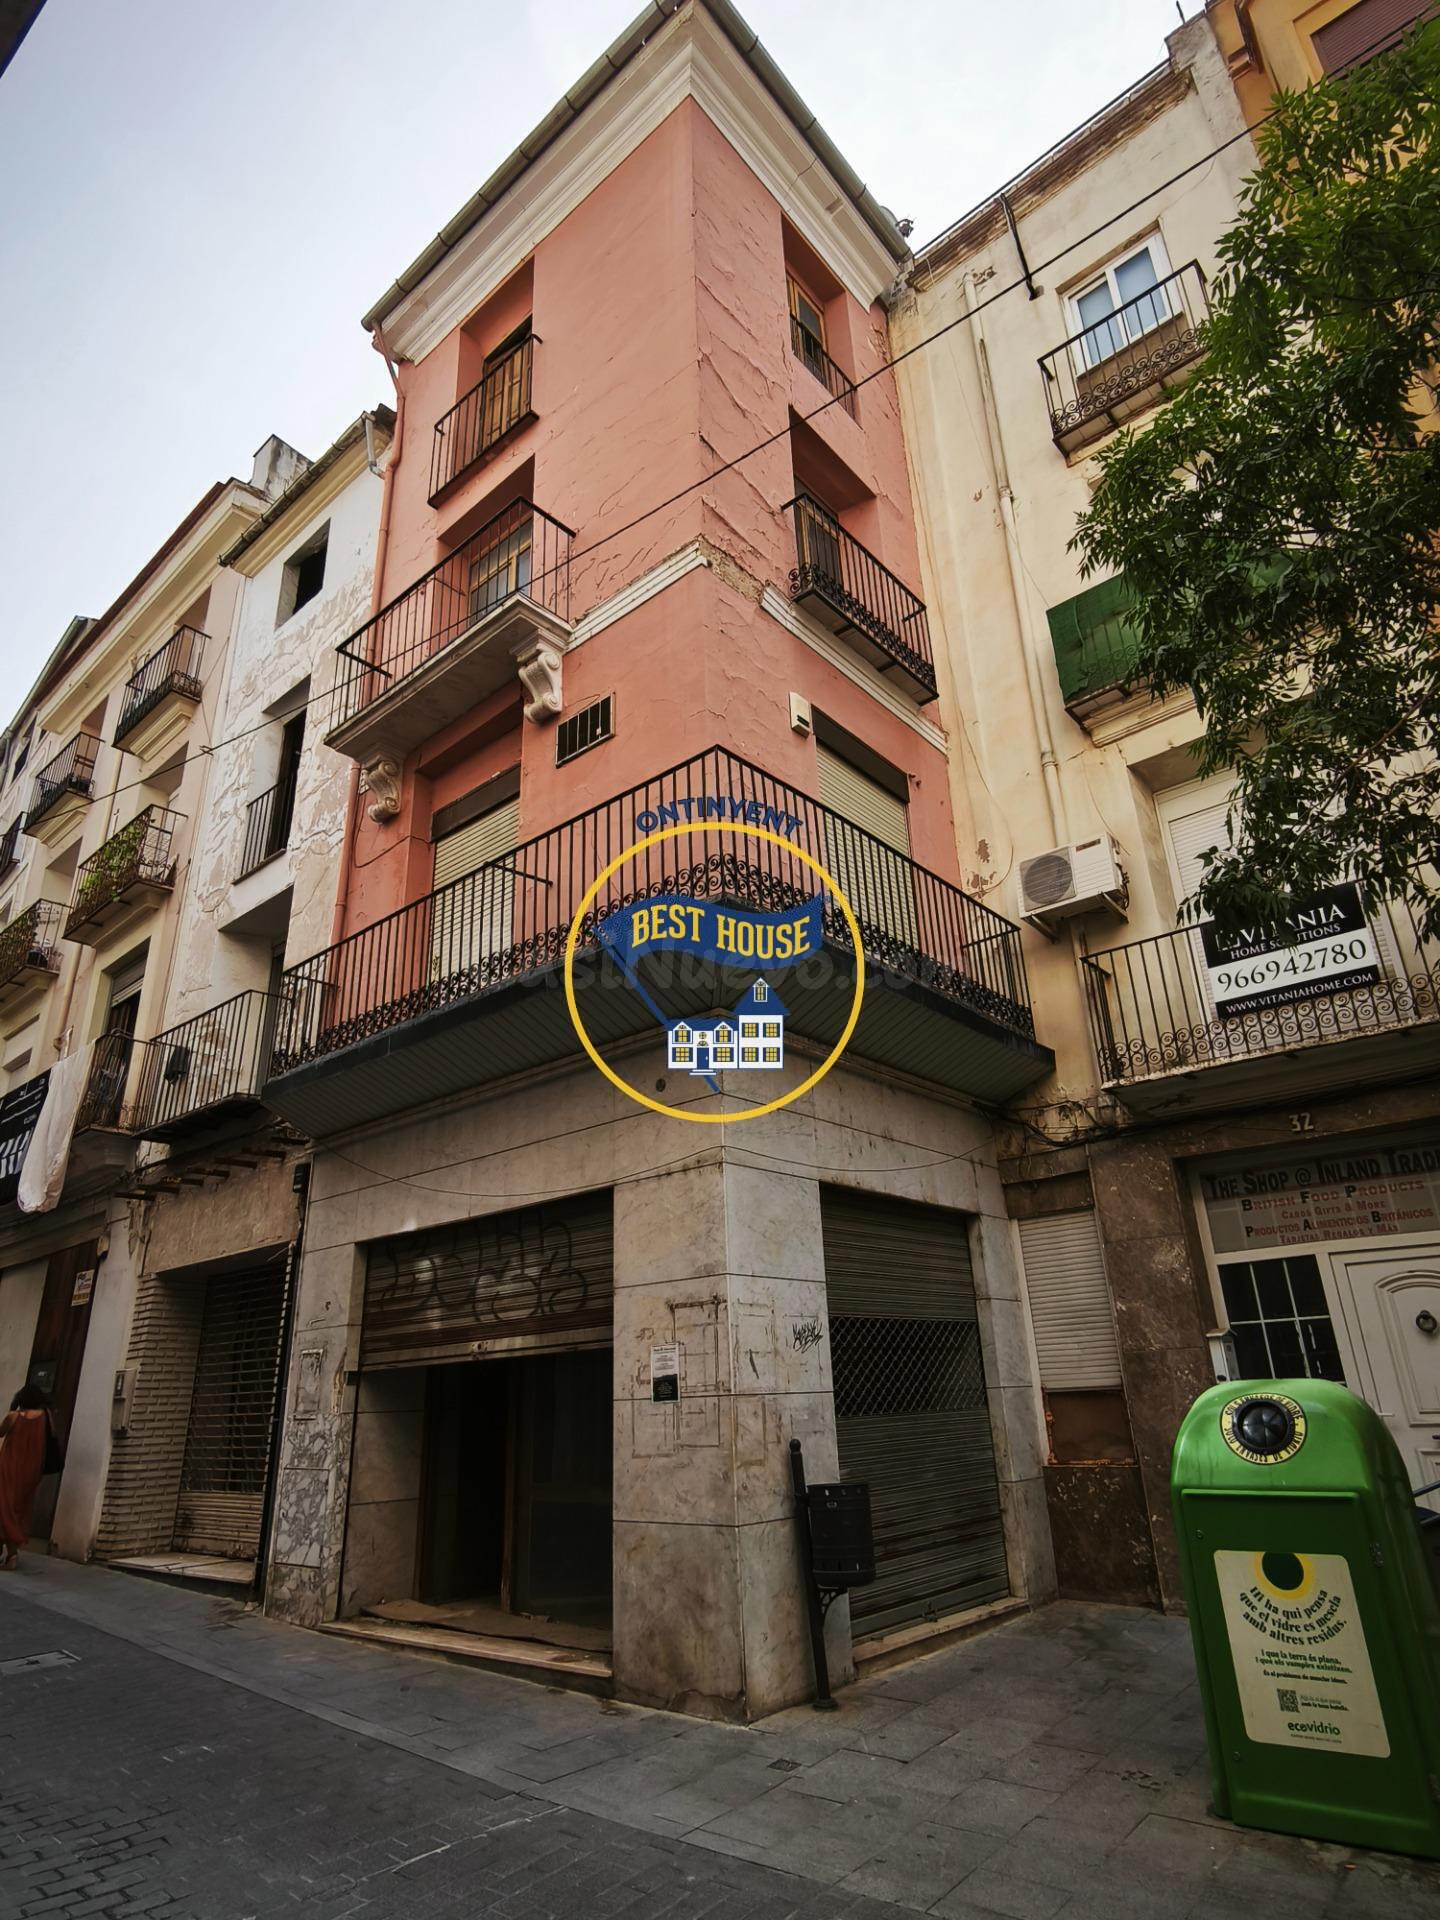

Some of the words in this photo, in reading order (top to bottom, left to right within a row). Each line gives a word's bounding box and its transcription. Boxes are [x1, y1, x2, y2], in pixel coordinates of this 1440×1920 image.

[1231, 941, 1268, 960] HOME
[1270, 923, 1341, 950] SOUTIONS
[1217, 938, 1367, 993] 966942780
[1288, 1112, 1315, 1132] 32
[1242, 1167, 1289, 1195] SHOP
[1316, 1158, 1381, 1184] INLAND
[1344, 1180, 1425, 1199] PRODUCTS
[1239, 1592, 1258, 1612] que
[1258, 1610, 1270, 1623] el
[1271, 1617, 1302, 1633] vidre
[1315, 1595, 1342, 1628] mescla
[1264, 1598, 1279, 1615] ha
[1282, 1607, 1303, 1620] qui
[1304, 1589, 1329, 1618] pensa
[1242, 1611, 1267, 1633] amb
[1269, 1629, 1305, 1646] altres
[1307, 1619, 1347, 1645] residus.
[1287, 1720, 1341, 1736] ecovidrio
